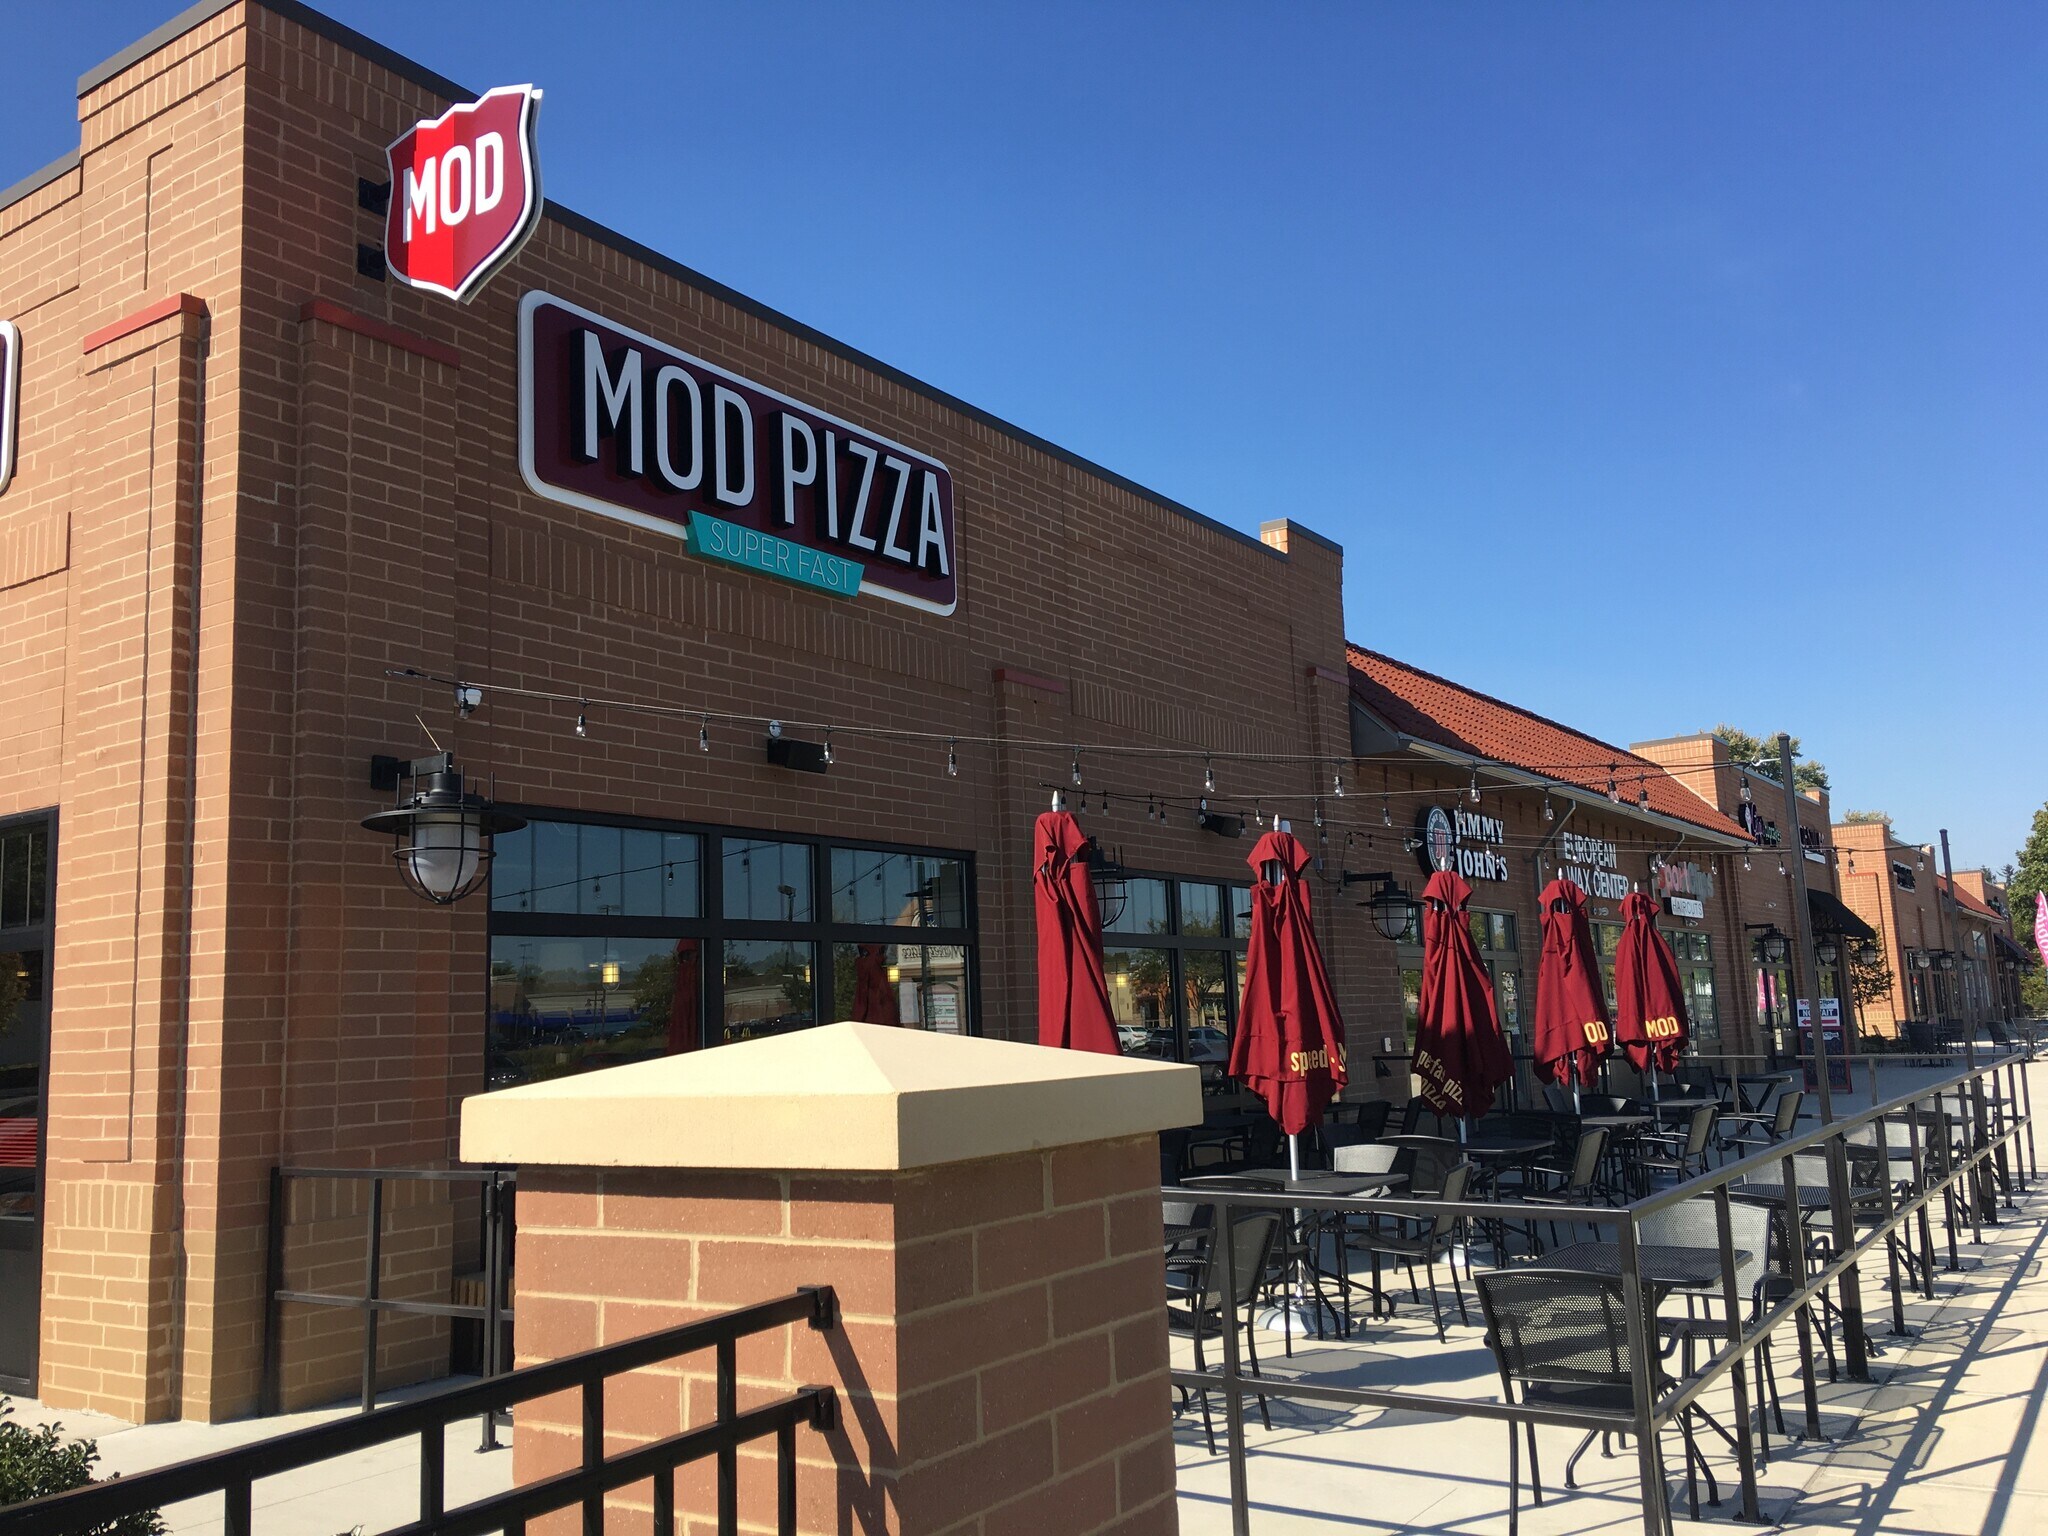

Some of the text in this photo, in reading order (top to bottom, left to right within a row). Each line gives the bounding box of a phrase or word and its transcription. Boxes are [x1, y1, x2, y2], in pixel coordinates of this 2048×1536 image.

[403, 131, 504, 243] MOD
[582, 329, 950, 577] MOD PIZZA
[710, 520, 852, 590] SUPER FAST
[1453, 809, 1504, 844] JIMMY
[1563, 831, 1618, 869] EUROPEAN
[1566, 865, 1630, 900] WAX CENTER
[1672, 898, 1703, 916] HAIRCUTS
[1645, 1016, 1679, 1039] MOD
[1820, 1008, 1833, 1017] AIT
[1584, 1021, 1608, 1043] OD
